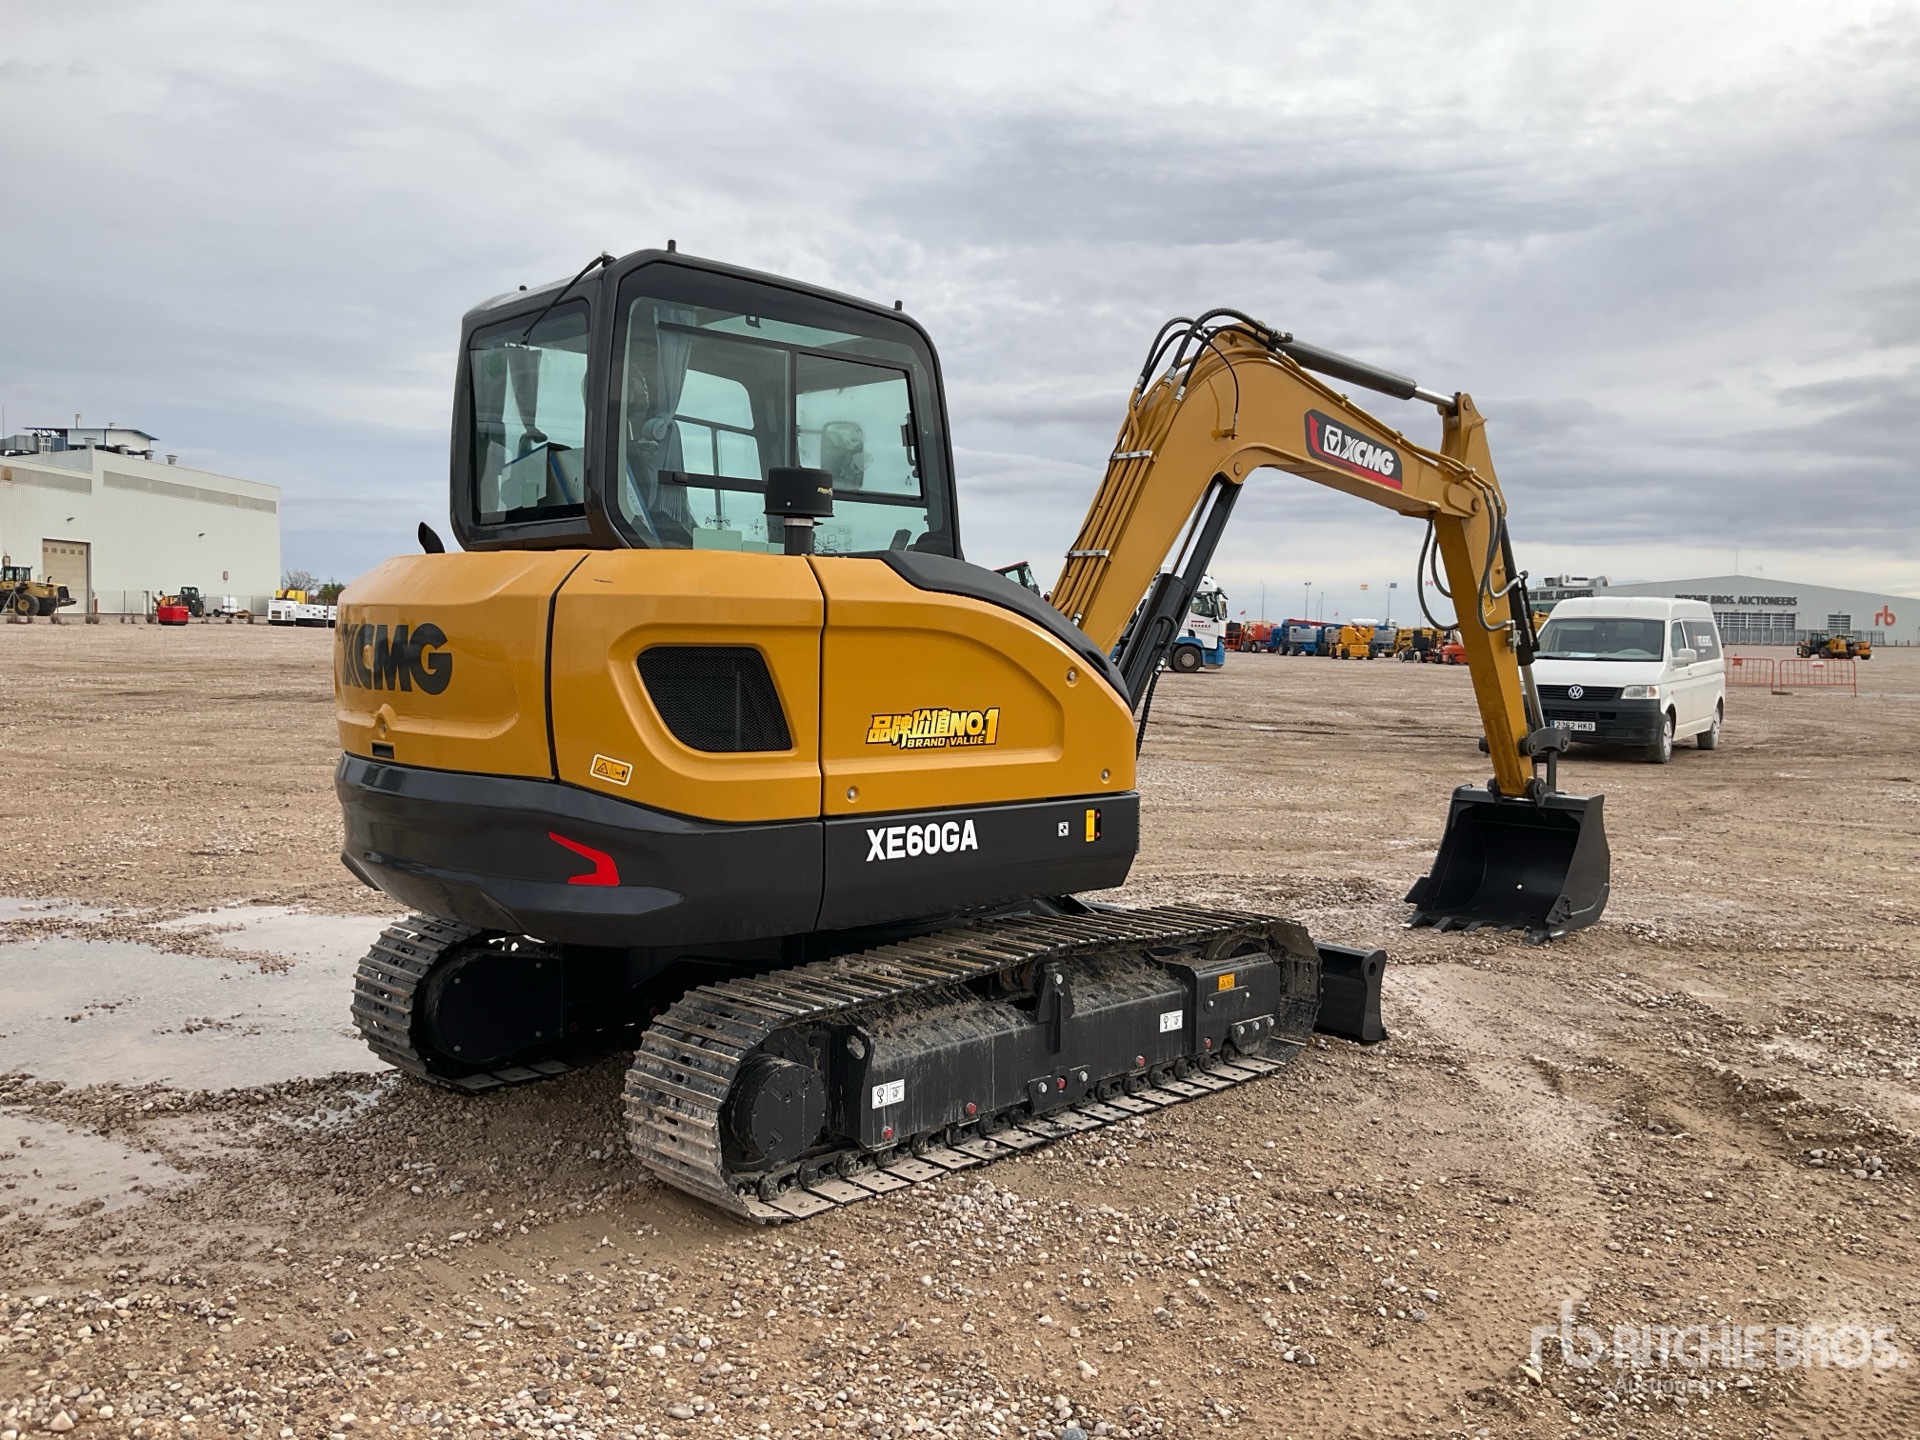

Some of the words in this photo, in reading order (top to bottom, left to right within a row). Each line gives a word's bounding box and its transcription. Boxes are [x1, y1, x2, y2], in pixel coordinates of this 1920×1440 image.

[1339, 434, 1394, 476] XCMG
[1710, 595, 1736, 605] BROS.
[1737, 596, 1797, 606] AUCTIONEERS
[1875, 605, 1896, 626] rb
[342, 622, 453, 695] XCMG
[907, 737, 946, 748] BRAND
[950, 735, 984, 746] VALUE
[866, 819, 978, 862] XE60GA
